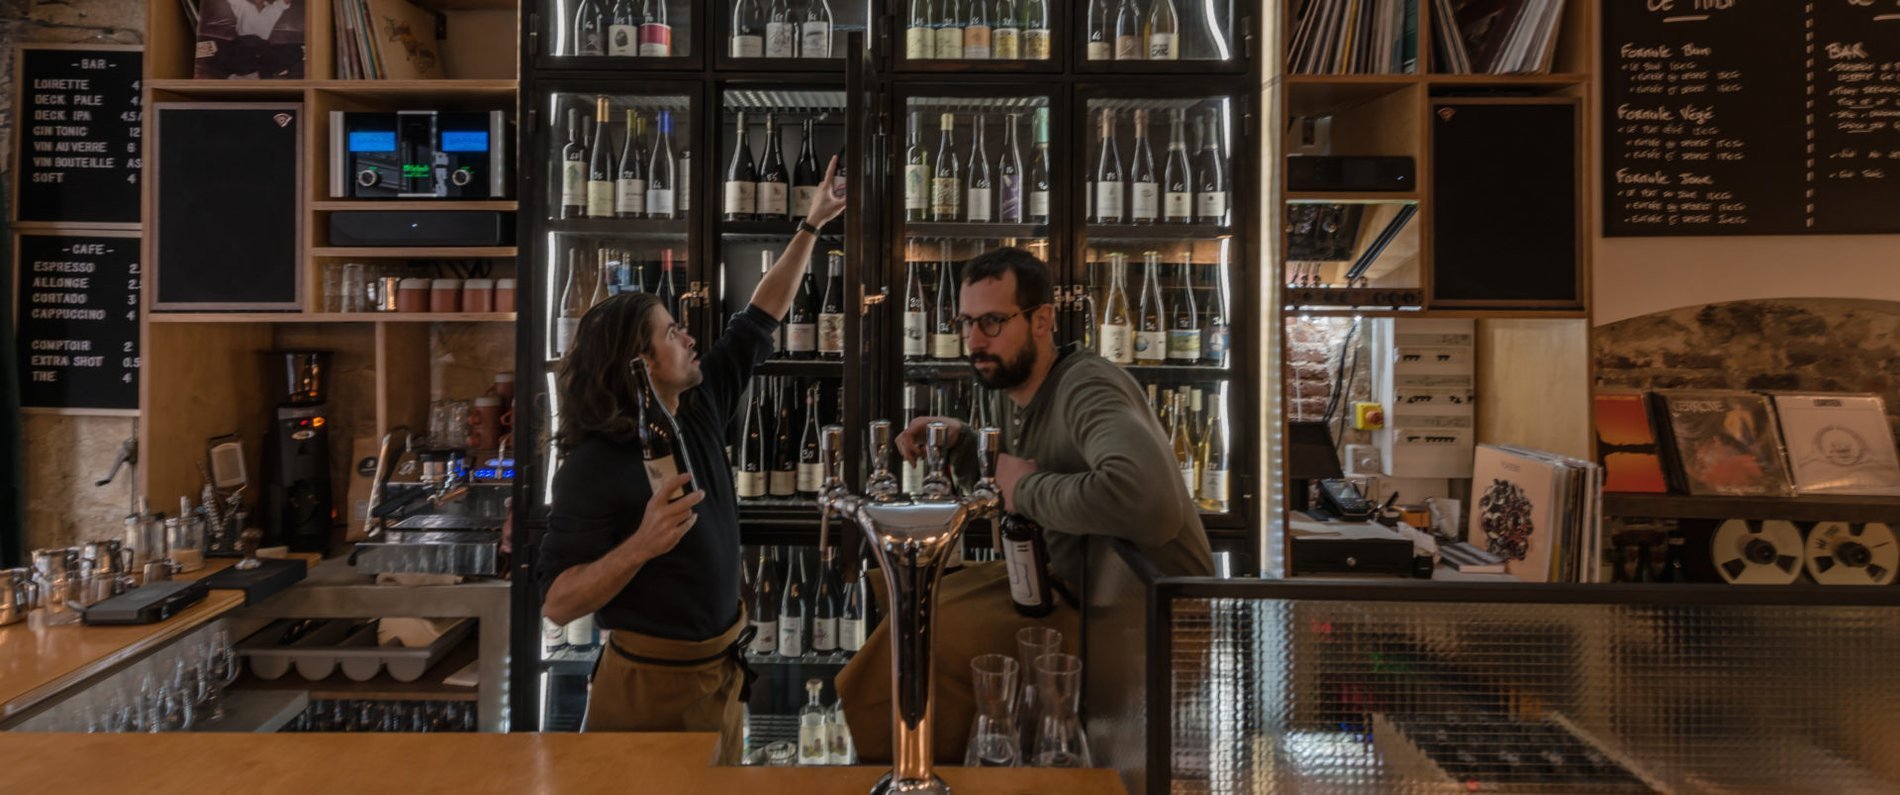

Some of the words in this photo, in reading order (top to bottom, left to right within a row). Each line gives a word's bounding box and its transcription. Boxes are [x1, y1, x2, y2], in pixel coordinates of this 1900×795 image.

[81, 58, 107, 70] BAR
[34, 78, 90, 90] LOIRETTE
[35, 94, 66, 105] DECK
[73, 95, 103, 106] PALE
[35, 110, 66, 121] DECK
[72, 110, 92, 121] IPA
[33, 126, 53, 136] GIN
[55, 126, 89, 137] TONIC
[34, 141, 52, 151] VIN
[55, 142, 70, 152] AU
[70, 142, 108, 153] VERRE
[33, 157, 51, 167] VIN
[55, 157, 115, 169] BOUTEILLE
[32, 172, 65, 183] SOFT
[127, 173, 137, 184] 4
[73, 243, 104, 256] CAFE
[33, 261, 96, 273] ESPRESSO
[33, 277, 90, 289] ALLONGE
[32, 292, 88, 304] CORTADO
[127, 294, 137, 305] 3
[32, 308, 106, 320] CAPPUCCINO
[126, 310, 136, 321] 4
[32, 339, 91, 351] COMPTOIR
[123, 341, 134, 352] 2
[32, 355, 69, 366] EXTRA
[73, 355, 104, 367] SHOT
[33, 370, 56, 382] THE
[122, 372, 133, 384] 4
